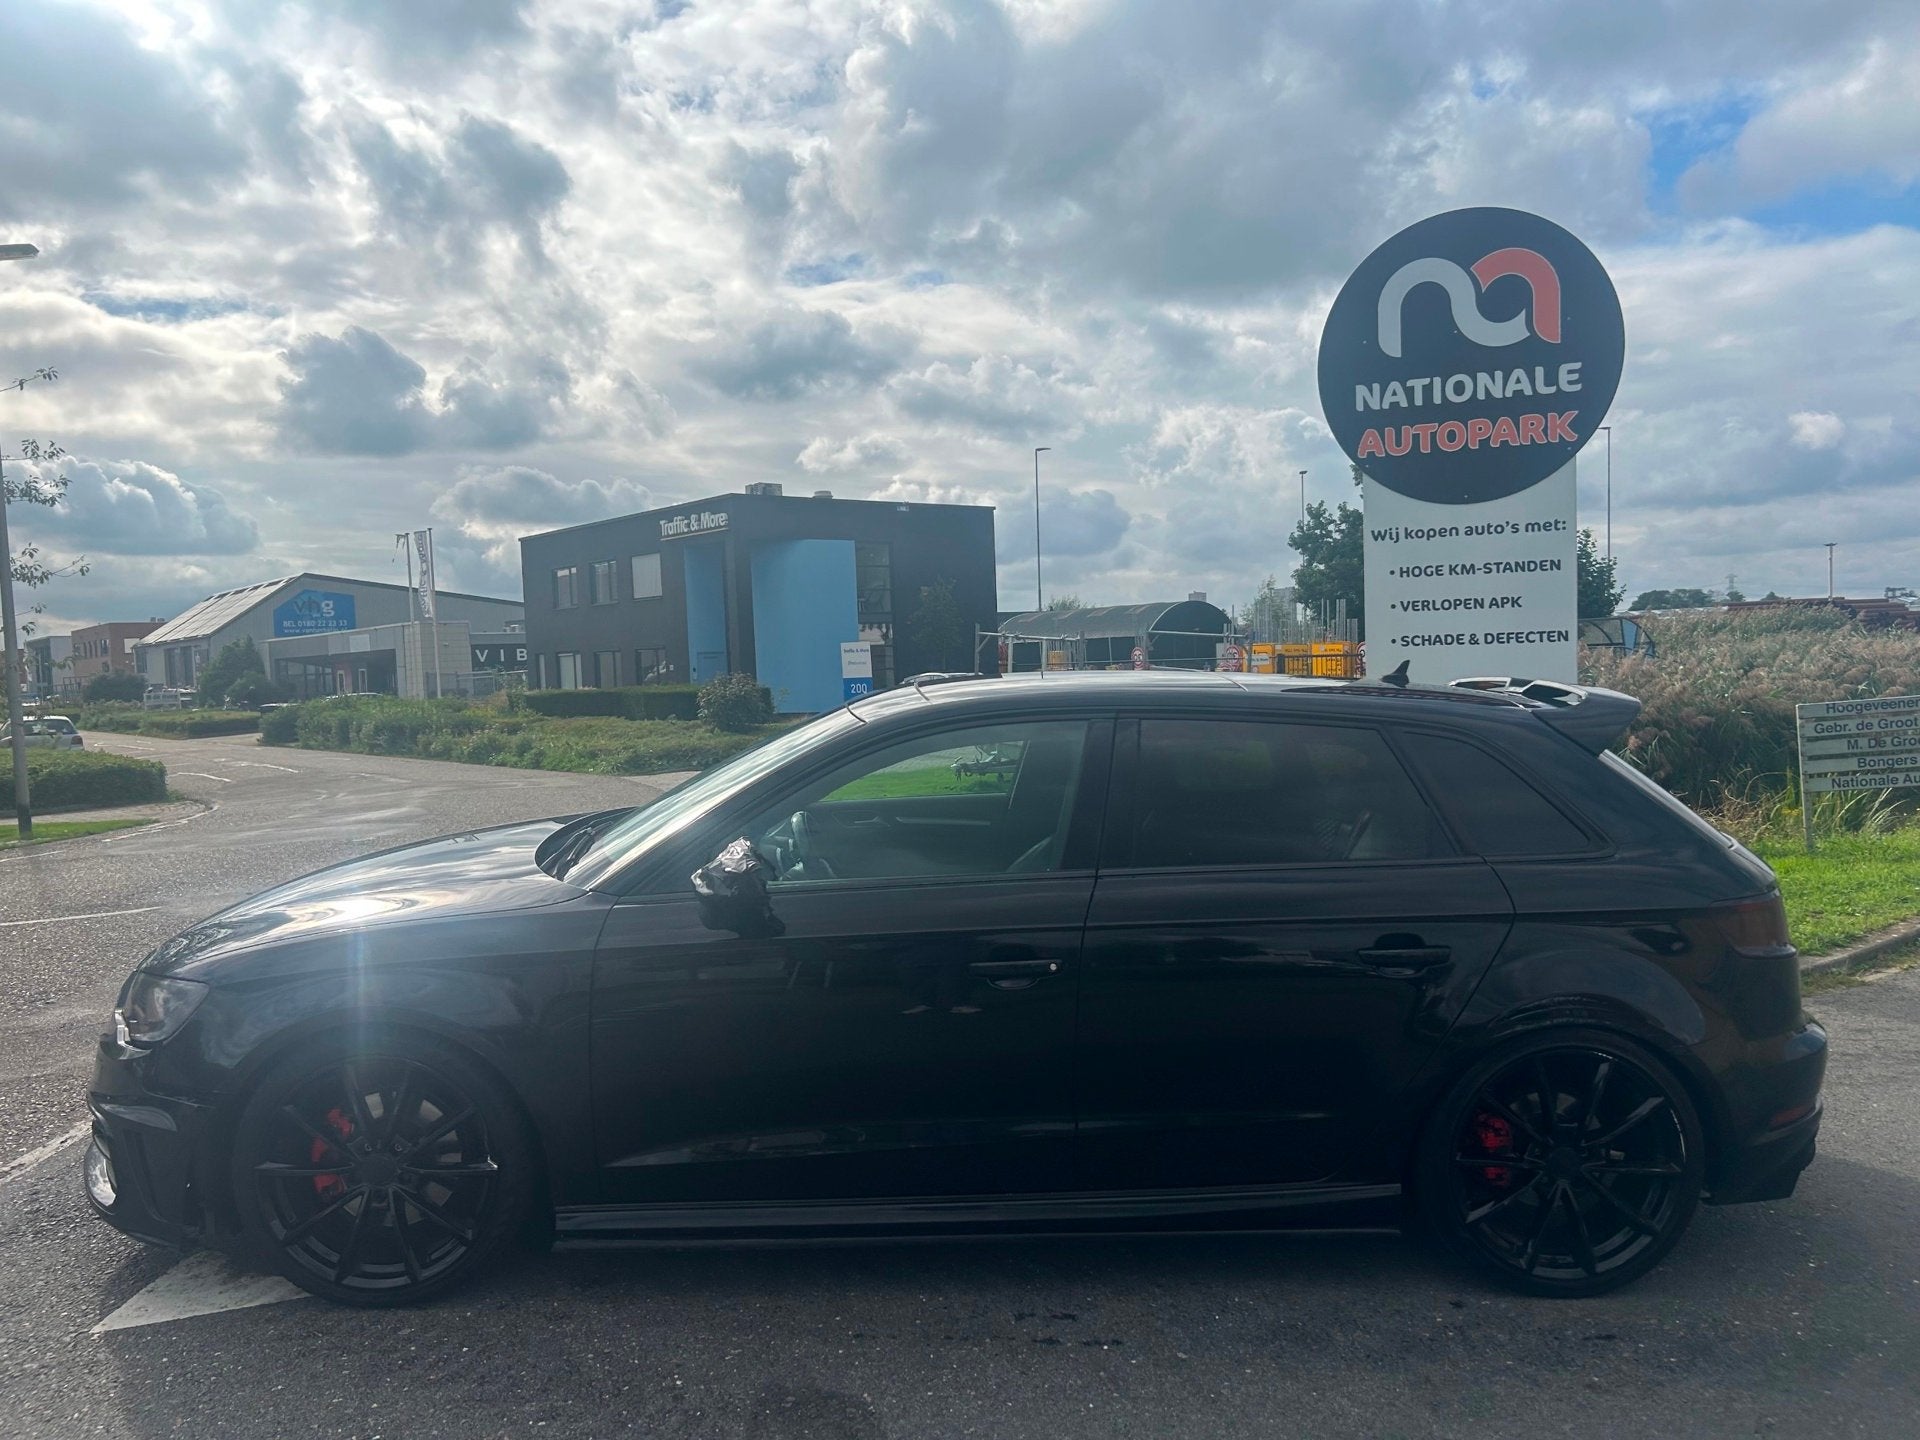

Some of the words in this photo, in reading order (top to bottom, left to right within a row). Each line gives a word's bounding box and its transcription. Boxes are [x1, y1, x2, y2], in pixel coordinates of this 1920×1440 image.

[1355, 362, 1582, 412] NATIONALE
[1357, 411, 1579, 458] AUTOPARK
[660, 516, 690, 536] Traffic
[690, 514, 699, 531] &
[701, 511, 728, 529] More
[1371, 527, 1399, 543] Wij
[1404, 526, 1459, 541] kopen
[1464, 520, 1520, 536] auto's
[1524, 518, 1567, 533] met:
[1399, 564, 1444, 578] HOGE
[1449, 558, 1562, 576] KM-STANDEN
[1400, 597, 1485, 612] VERLOPEN
[1488, 596, 1522, 609] APK
[1400, 633, 1465, 647] SCHADE
[1468, 632, 1480, 645] &
[1484, 630, 1569, 644] DEFECTEN
[851, 683, 868, 694] 200
[1814, 721, 1851, 734] Gebr.
[1856, 720, 1873, 731] de
[1878, 716, 1918, 730] Groot
[1847, 739, 1862, 750] M.
[1868, 738, 1886, 748] De
[1857, 756, 1918, 768] Bongers
[1832, 775, 1899, 789] Nationale
